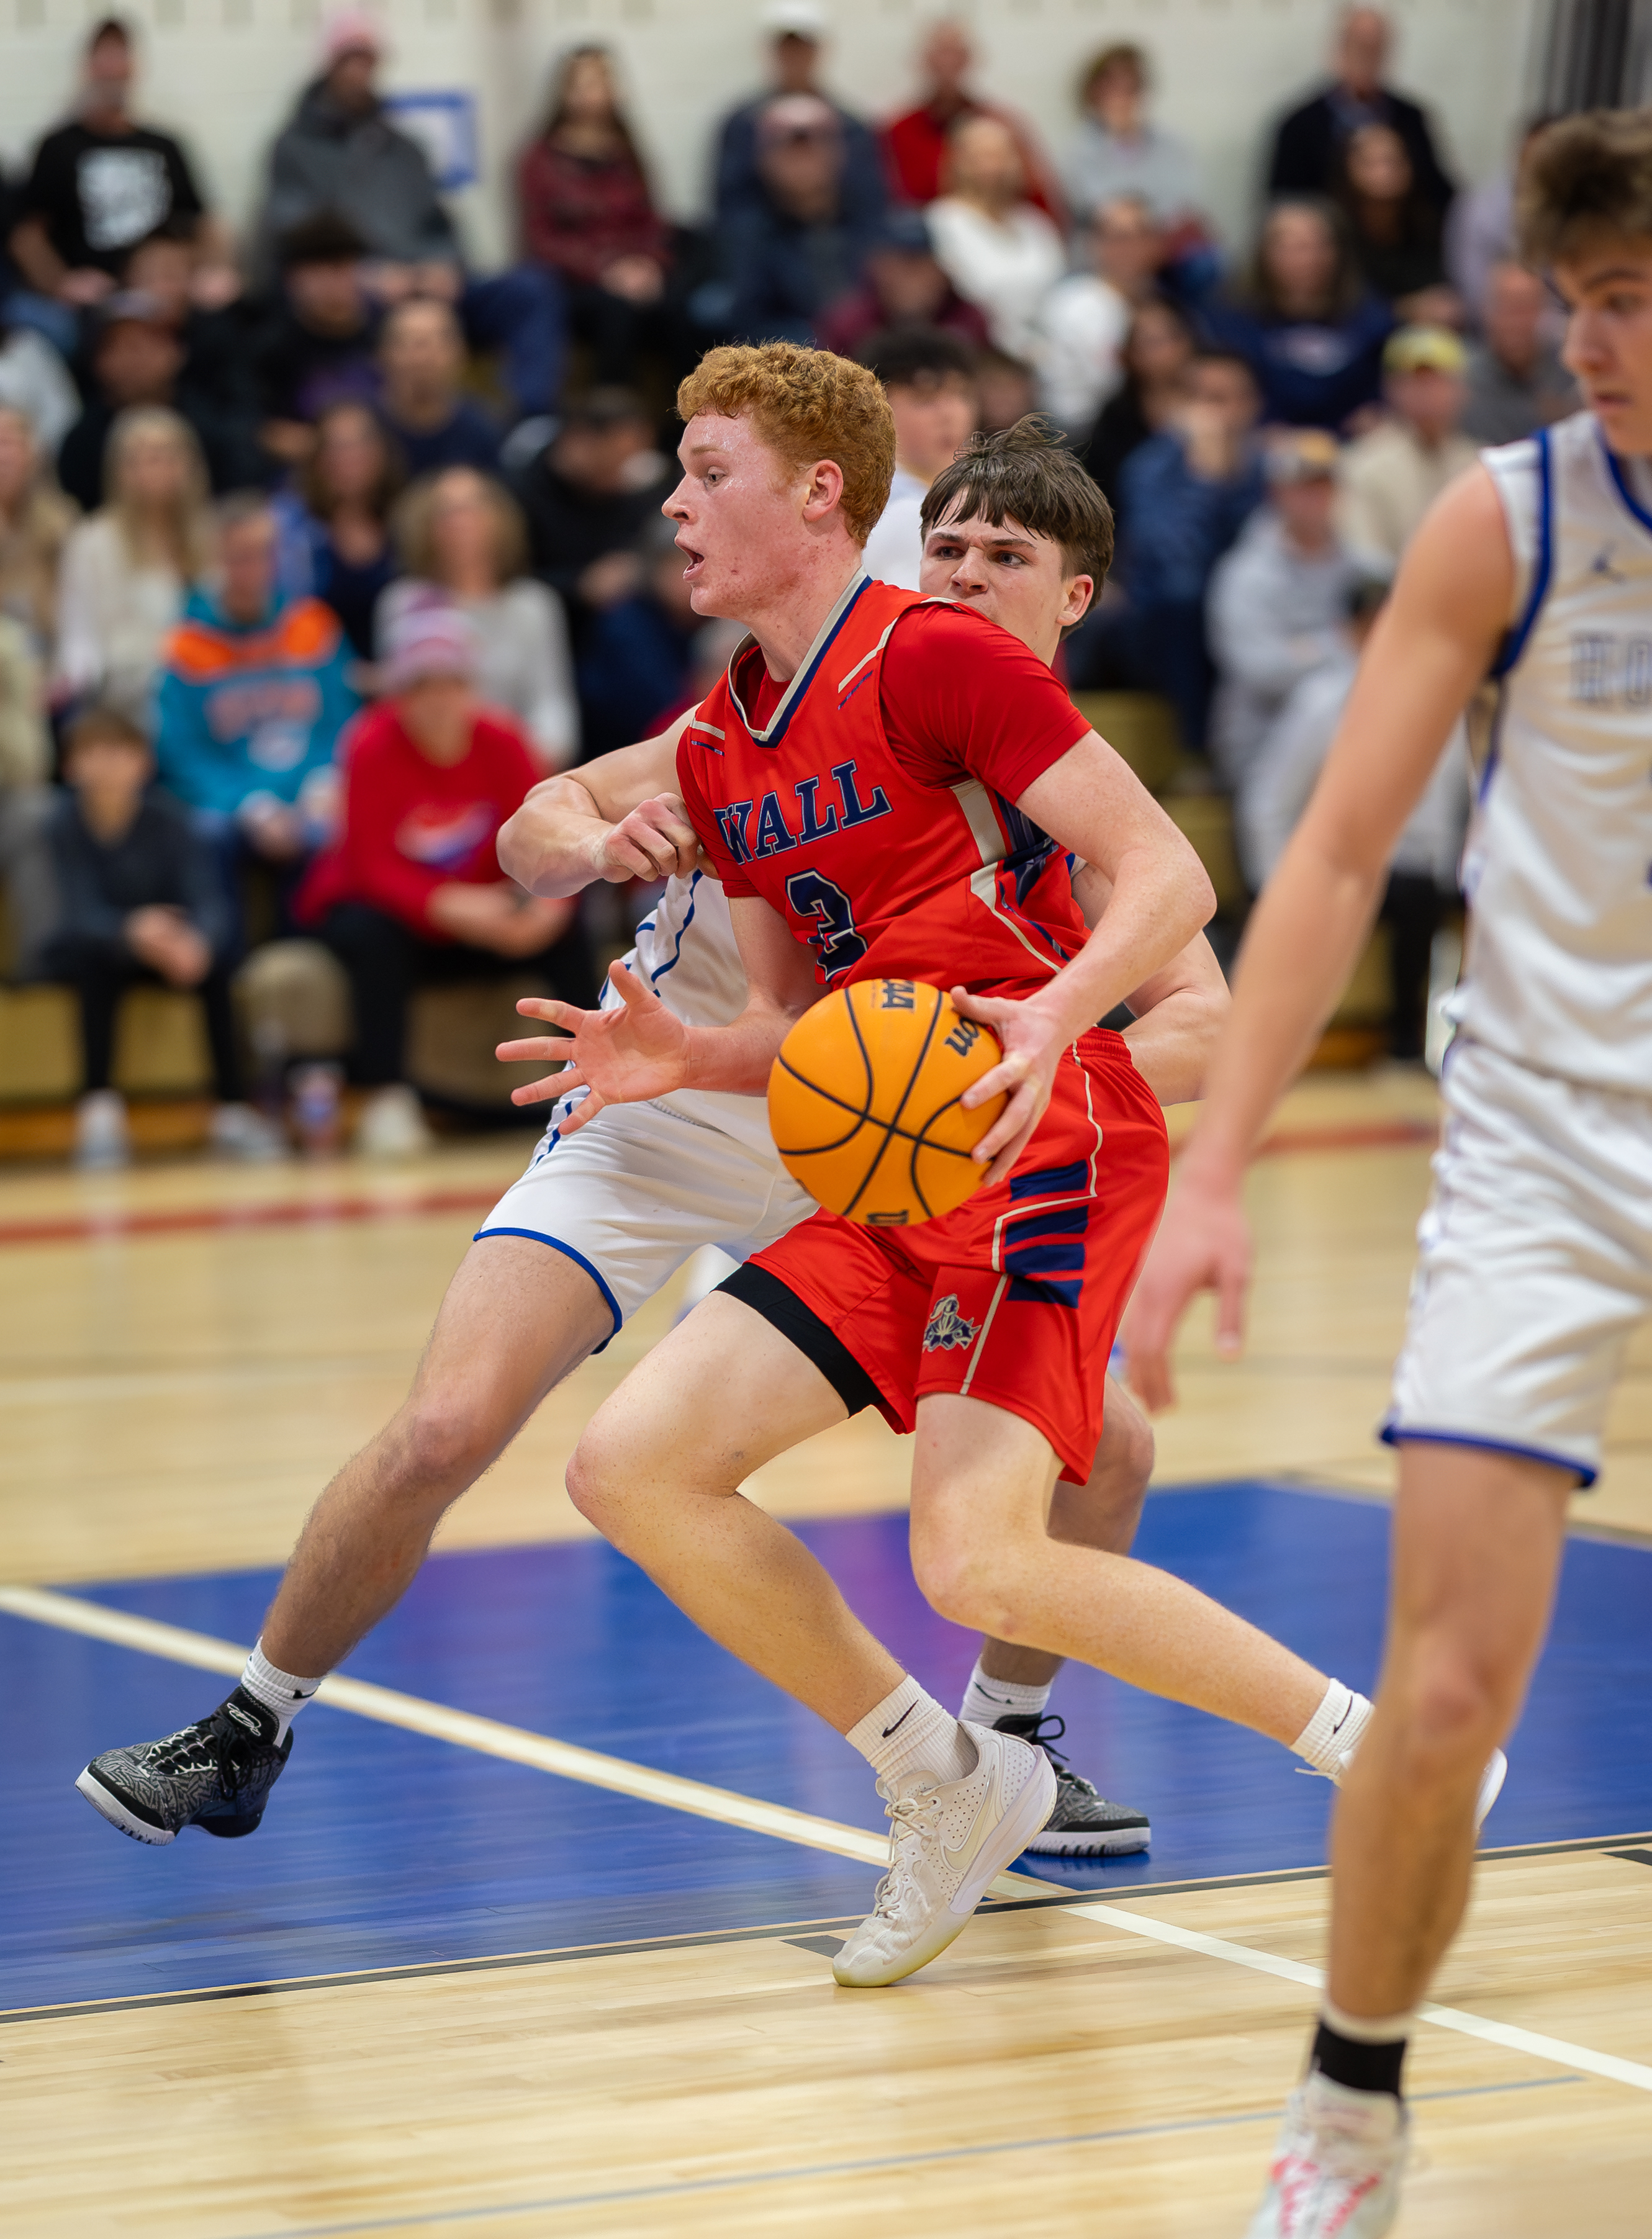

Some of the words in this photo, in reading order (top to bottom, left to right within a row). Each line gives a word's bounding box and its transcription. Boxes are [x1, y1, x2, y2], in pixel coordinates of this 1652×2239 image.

[713, 759, 893, 865] WALL
[785, 867, 868, 983] 3
[882, 978, 914, 1008] AA
[944, 1016, 980, 1056] on
